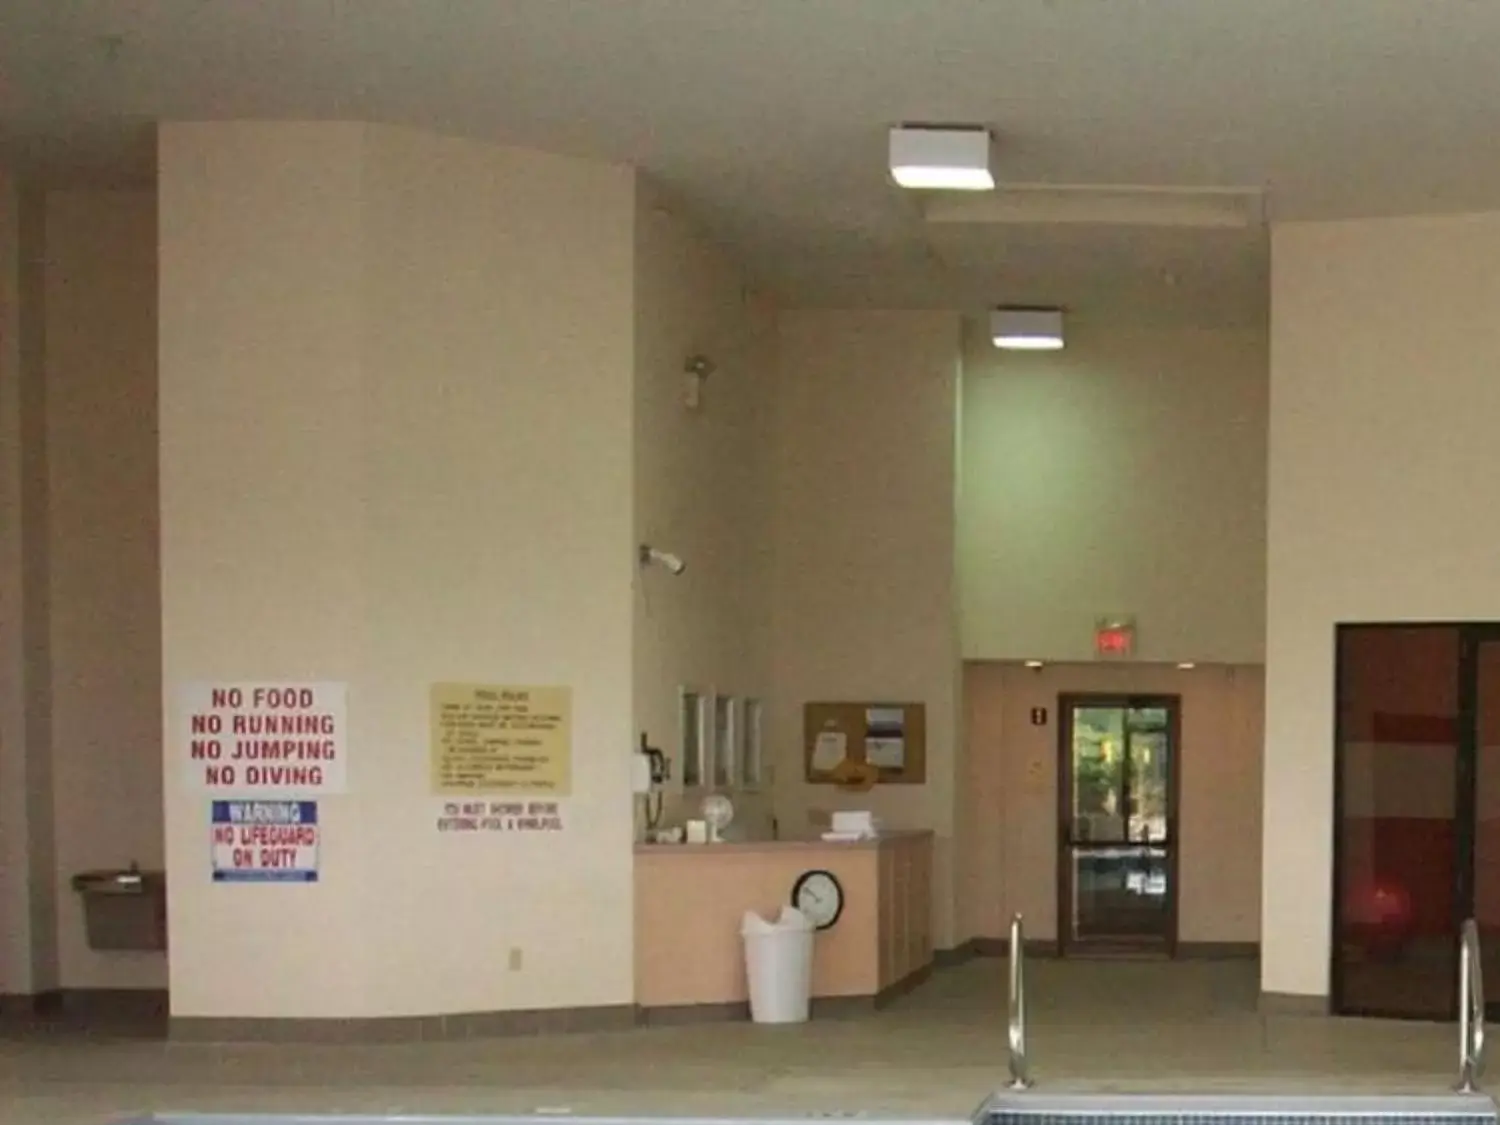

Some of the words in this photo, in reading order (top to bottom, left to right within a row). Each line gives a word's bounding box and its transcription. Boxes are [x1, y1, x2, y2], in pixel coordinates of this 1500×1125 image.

[212, 688, 243, 709] NO
[253, 688, 314, 709] FOOD
[191, 714, 222, 735] NO
[232, 714, 335, 735] RUNNING
[191, 740, 222, 760] NO
[231, 740, 336, 760] JUMPING
[205, 765, 235, 785] NO
[246, 765, 323, 785] DIVING
[229, 802, 301, 822] WARNING
[215, 826, 234, 845] NO
[241, 826, 315, 846] LIFEGUARD
[233, 848, 253, 867] ON
[260, 848, 297, 867] DUTY
